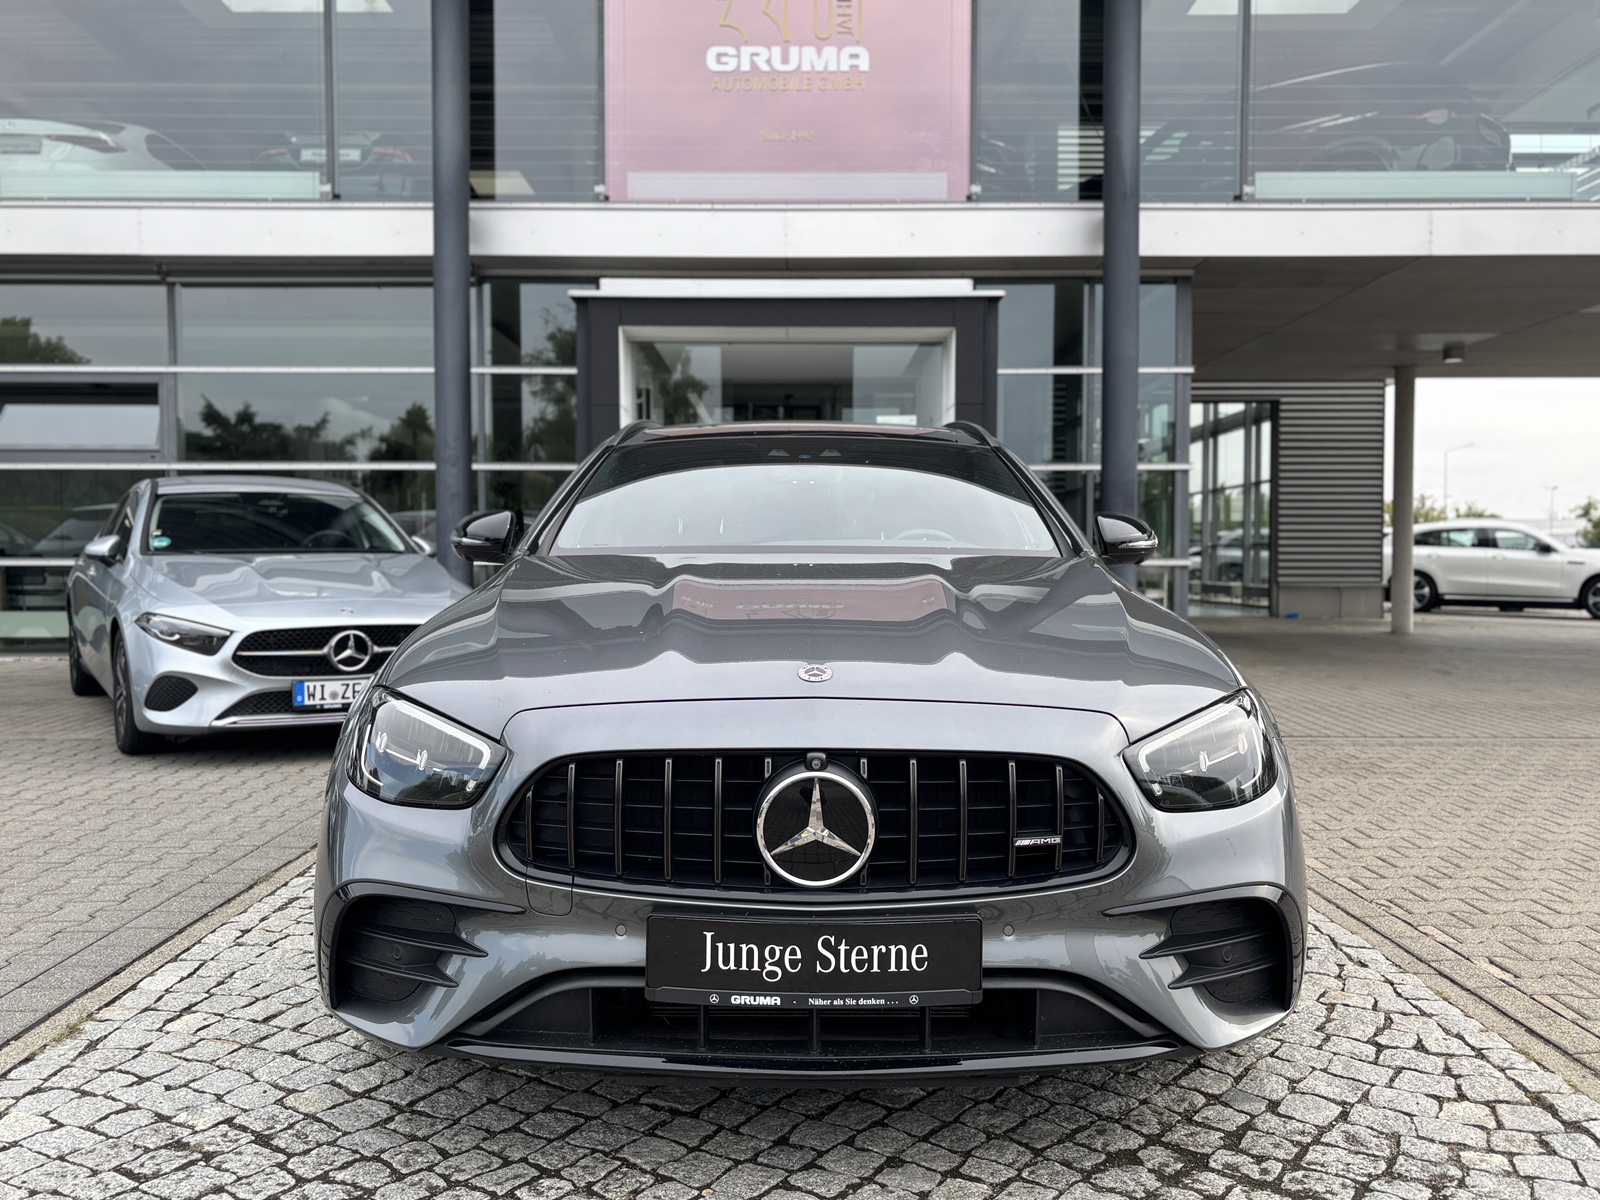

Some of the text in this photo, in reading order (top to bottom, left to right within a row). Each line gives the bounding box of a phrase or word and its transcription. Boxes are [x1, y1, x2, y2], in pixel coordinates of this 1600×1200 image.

[705, 45, 870, 73] GRUMA
[711, 77, 812, 92] AUTOMOBILE
[307, 685, 326, 701] WI
[701, 931, 929, 982] Junge Sterne
[731, 995, 781, 1006] GRUMA
[808, 997, 831, 1006] Näher
[833, 997, 844, 1005] als
